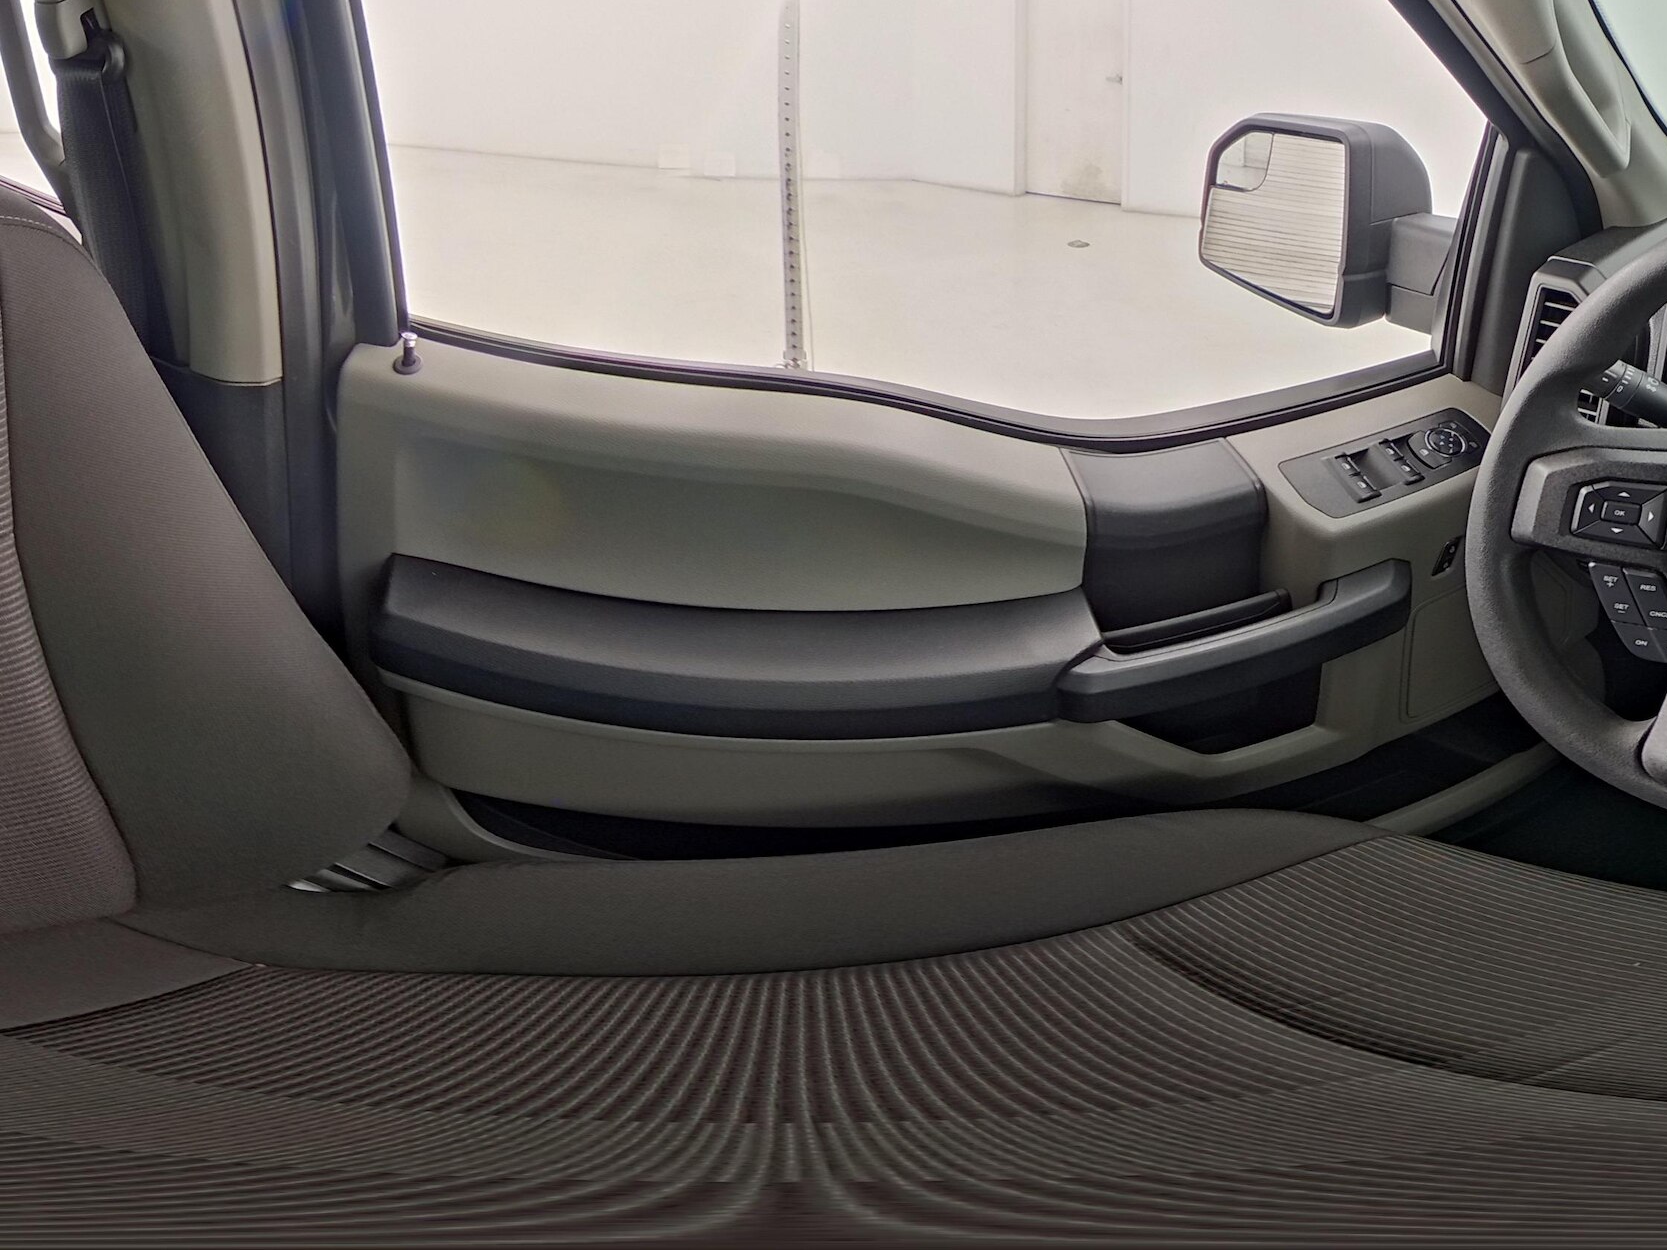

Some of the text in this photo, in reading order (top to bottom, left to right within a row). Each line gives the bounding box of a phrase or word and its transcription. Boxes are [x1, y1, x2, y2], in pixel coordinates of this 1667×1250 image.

[1614, 509, 1625, 517] OK
[1640, 584, 1657, 592] RES
[1613, 603, 1630, 611] SET
[1635, 639, 1648, 647] ON
